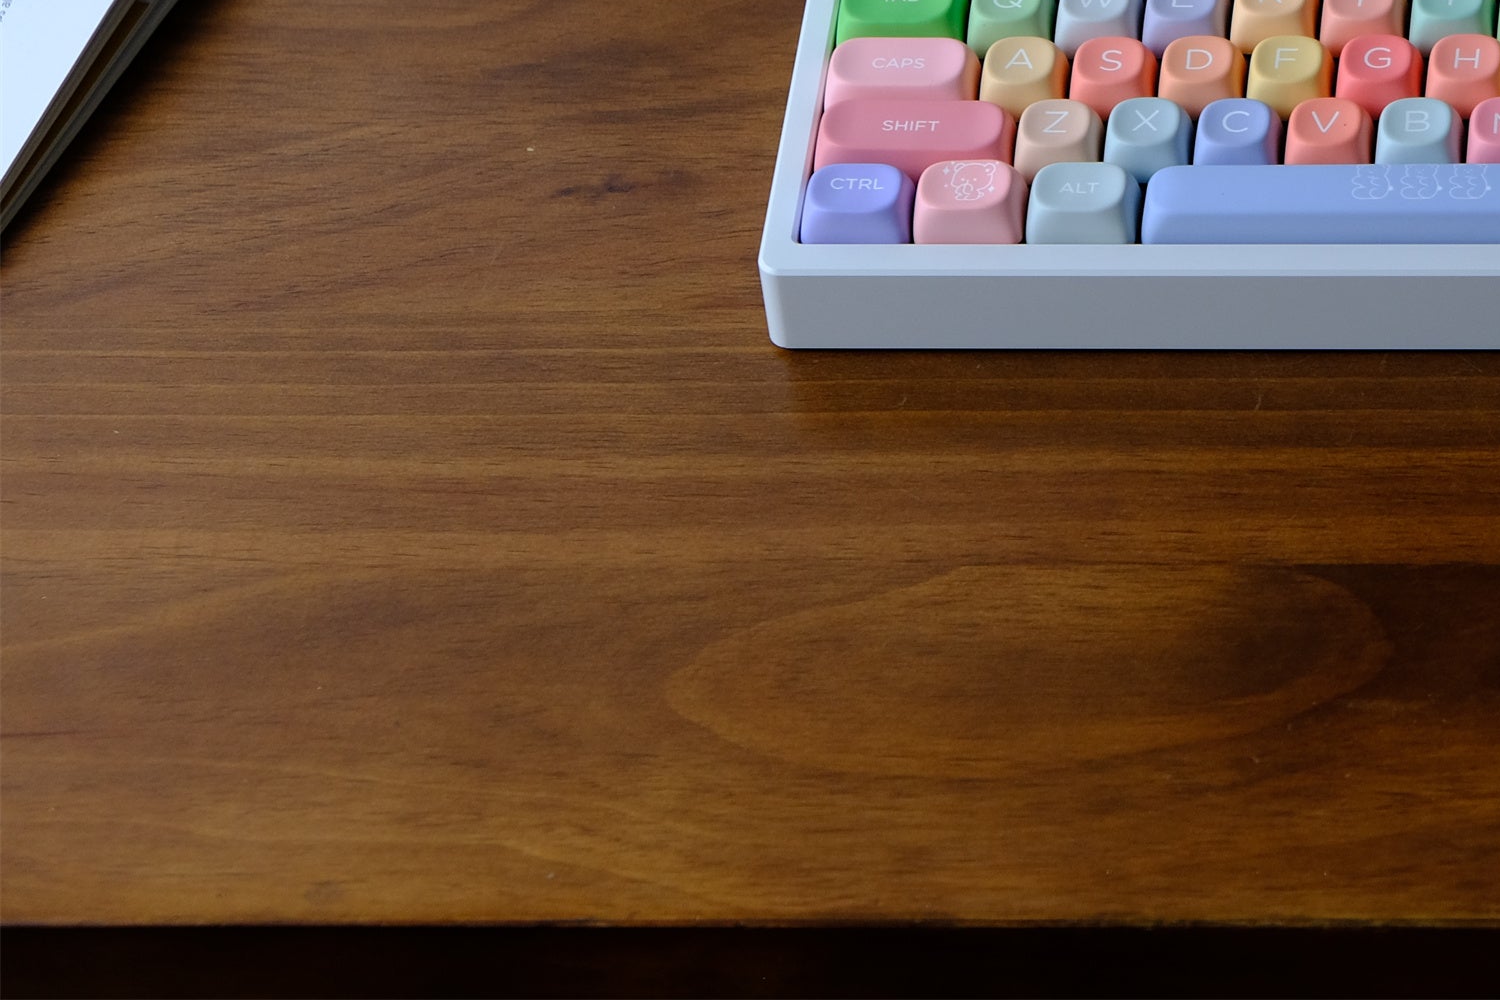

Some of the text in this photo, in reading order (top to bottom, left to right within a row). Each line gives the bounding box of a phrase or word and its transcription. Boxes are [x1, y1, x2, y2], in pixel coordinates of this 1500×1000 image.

[871, 57, 926, 70] CAPS
[1004, 48, 1033, 70] A
[1099, 49, 1123, 71] S
[1186, 49, 1213, 71] D
[1273, 47, 1299, 69] F
[1363, 47, 1392, 69] G
[1453, 47, 1480, 69] H
[881, 119, 940, 132] SHIFT
[1043, 110, 1068, 133] Z
[1132, 109, 1158, 132] X
[1221, 110, 1251, 133] C
[1310, 110, 1340, 133] V
[1404, 110, 1430, 132] B
[830, 177, 885, 191] CTRL
[1058, 181, 1100, 194] ALT
